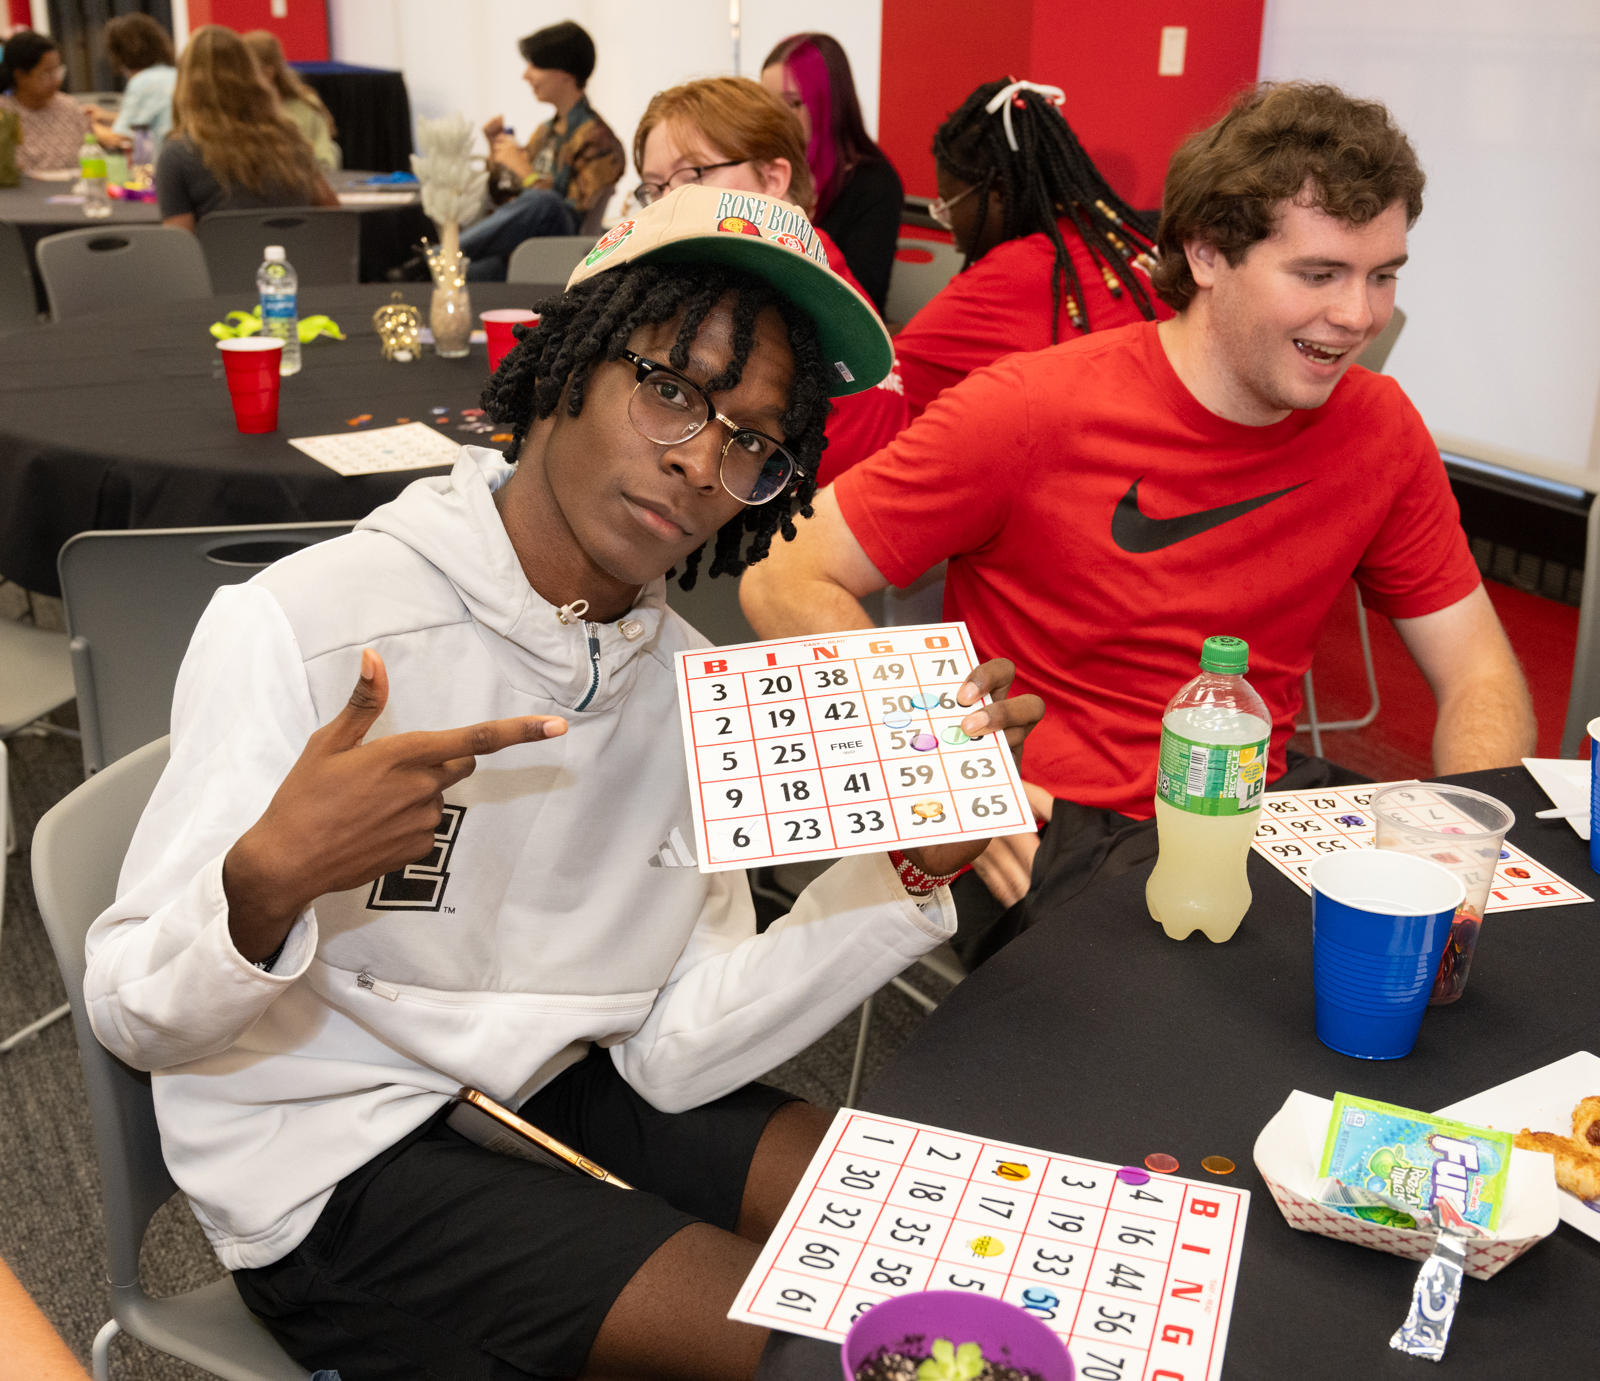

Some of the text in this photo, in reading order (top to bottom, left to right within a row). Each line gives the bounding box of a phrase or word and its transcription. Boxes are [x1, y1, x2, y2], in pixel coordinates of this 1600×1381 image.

[714, 192, 768, 227] ROSE
[765, 204, 816, 258] BOWL
[703, 636, 950, 675] B I N G O
[711, 658, 960, 701] 3 20 38 49 71
[715, 717, 732, 735] 2
[767, 709, 796, 728] 19
[824, 701, 859, 722] 42
[881, 695, 915, 715] 50
[722, 751, 738, 771] 5
[771, 743, 807, 765] 25
[830, 740, 864, 751] FREE
[890, 729, 921, 751] 57
[725, 758, 996, 808] 9 18 41 59 63
[1222, 769, 1230, 798] REFRESH
[1228, 750, 1240, 798] RECYCLE
[1268, 802, 1298, 813] 58
[1308, 799, 1337, 809] 42
[732, 794, 1008, 848] 6 23 33 53 65
[1290, 820, 1322, 832] 56
[1272, 844, 1302, 857] 66
[1316, 840, 1348, 852] 55
[1532, 885, 1561, 896] B
[443, 906, 456, 914] TM
[926, 1146, 962, 1161] 2
[908, 1181, 946, 1202] 18
[1190, 1198, 1220, 1218] B
[776, 1135, 894, 1313] 1 30 32 60 61
[890, 1217, 932, 1246] 35
[948, 1160, 1029, 1291] 14 17 FREE 5
[1023, 1176, 1097, 1320] 3 19 33 50
[1181, 1243, 1211, 1255] I
[870, 1258, 912, 1287] 58
[1081, 1189, 1164, 1381] 4 16 44 56 70
[1171, 1278, 1204, 1303] N
[1161, 1324, 1194, 1346] G
